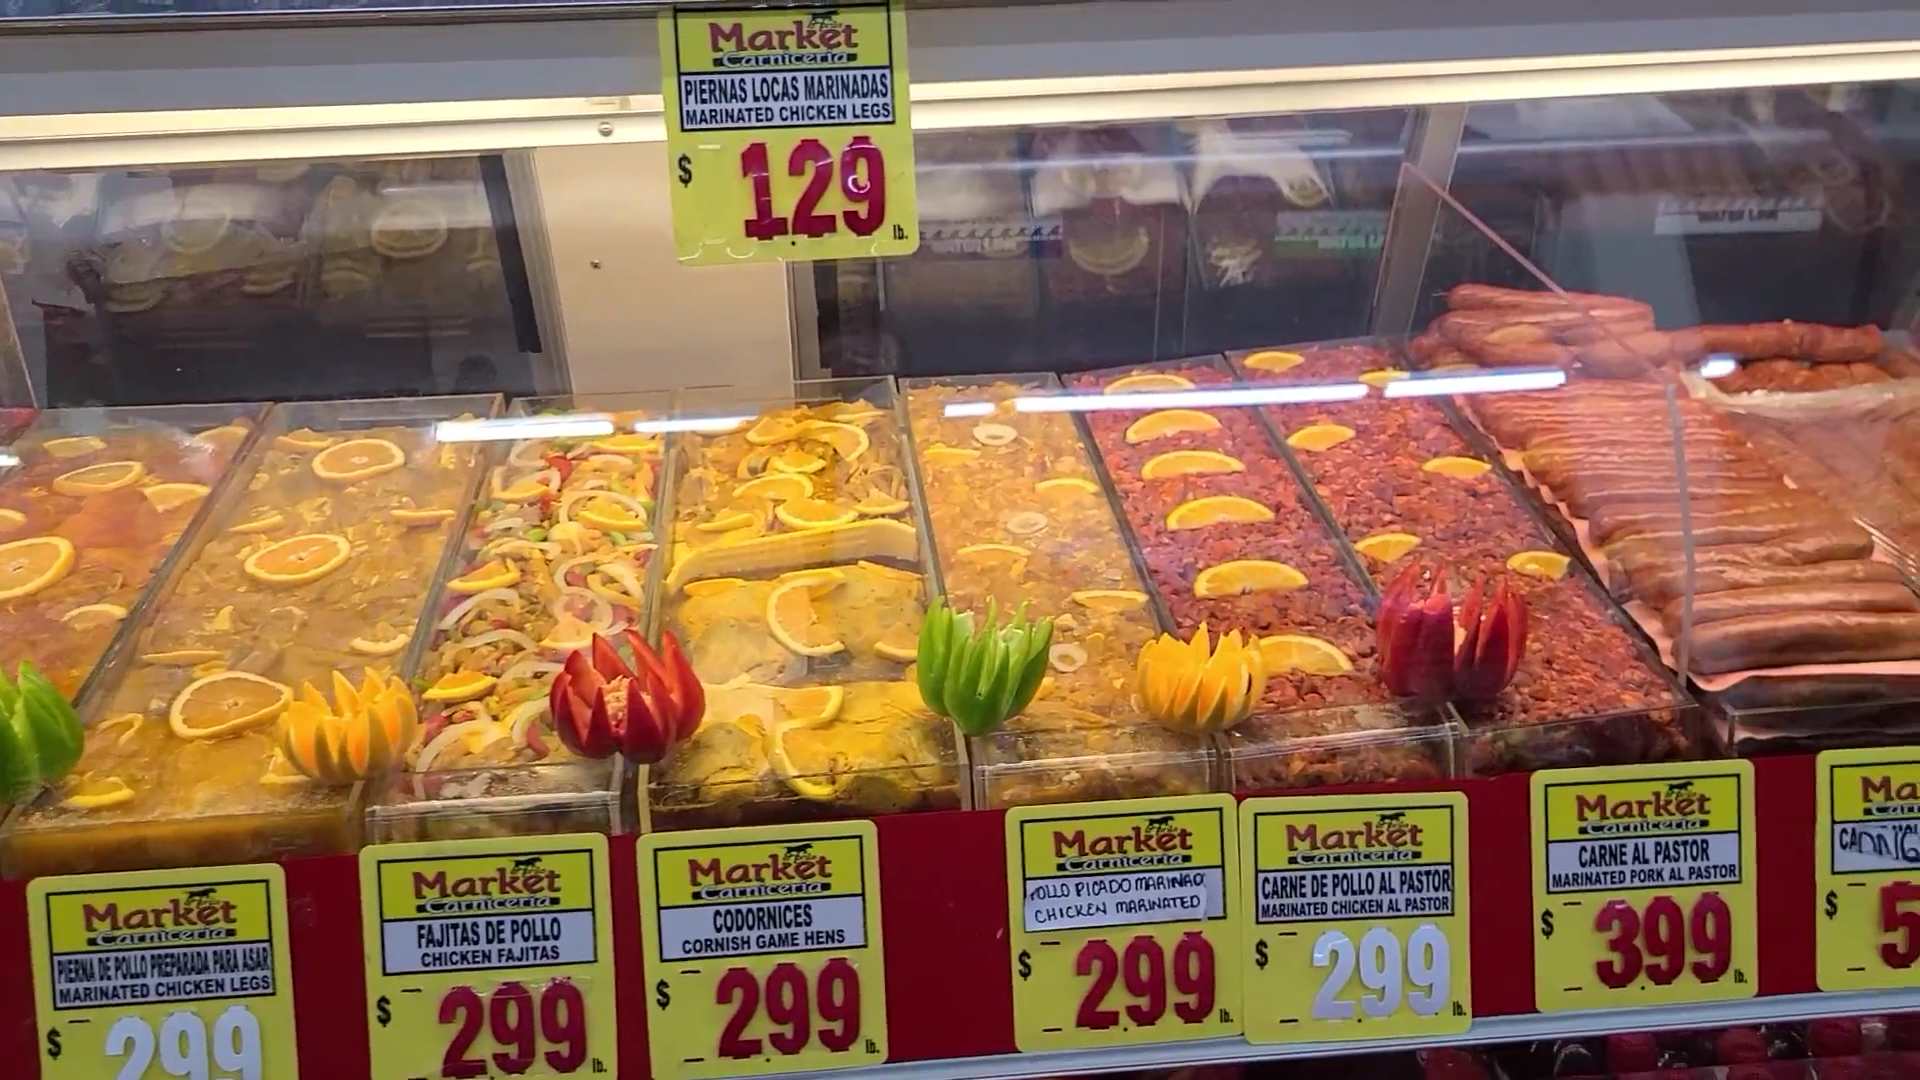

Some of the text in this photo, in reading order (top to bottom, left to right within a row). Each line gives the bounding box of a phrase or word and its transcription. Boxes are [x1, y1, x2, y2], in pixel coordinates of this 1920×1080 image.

[708, 20, 858, 53] Market
[722, 50, 848, 68] Carniceria
[685, 73, 888, 105] PIERNAS LOCAS MARINADAS
[686, 103, 890, 125] MARINATED CHICKEN LEGS
[678, 154, 692, 187] $
[893, 224, 909, 240] lb.
[1576, 791, 1711, 821] Market
[1053, 826, 1192, 857] Market
[1286, 821, 1423, 851] Market
[1586, 819, 1700, 835] Carniceria
[1065, 854, 1183, 872] Carniceria
[1296, 850, 1413, 865] Carniceria
[1579, 839, 1709, 868] CARNE AL PASTOR
[412, 868, 561, 899] Market
[688, 854, 832, 886] Market
[1262, 869, 1450, 899] CARNE DE POLLO AL PASTOR
[1552, 864, 1736, 888] MARINATED PORK AL PASTOR
[701, 882, 822, 899] Carniceria
[1075, 878, 1131, 897] PICADO
[83, 899, 238, 932] Market
[425, 895, 550, 913] Carniceria
[714, 904, 812, 933] CODORNICES
[1035, 895, 1200, 923] CHICKEN MARINATED
[1262, 896, 1449, 918] MARINATED CHICKEN AL PASTOR
[1825, 889, 1838, 920] $
[97, 928, 227, 947] Carniceria
[417, 917, 561, 949] FAJITAS DE POLLO
[1541, 909, 1553, 939] $
[421, 946, 559, 967] CHICKEN FAJITAS
[682, 929, 845, 954] CORNISH GAME HENS
[58, 947, 270, 983] PIERNA DE POLLO PREPARADA PARA ASAR
[1256, 939, 1268, 970] $
[1453, 1001, 1467, 1016] lb.
[59, 975, 270, 1003] MARINATED CHICKEN LEGS
[1019, 950, 1031, 981] $
[1219, 1008, 1233, 1023] lb.
[656, 979, 670, 1010] $
[865, 1039, 880, 1054] lb.
[47, 1027, 62, 1060] $
[377, 996, 391, 1027] $
[592, 1058, 607, 1073] lb.
